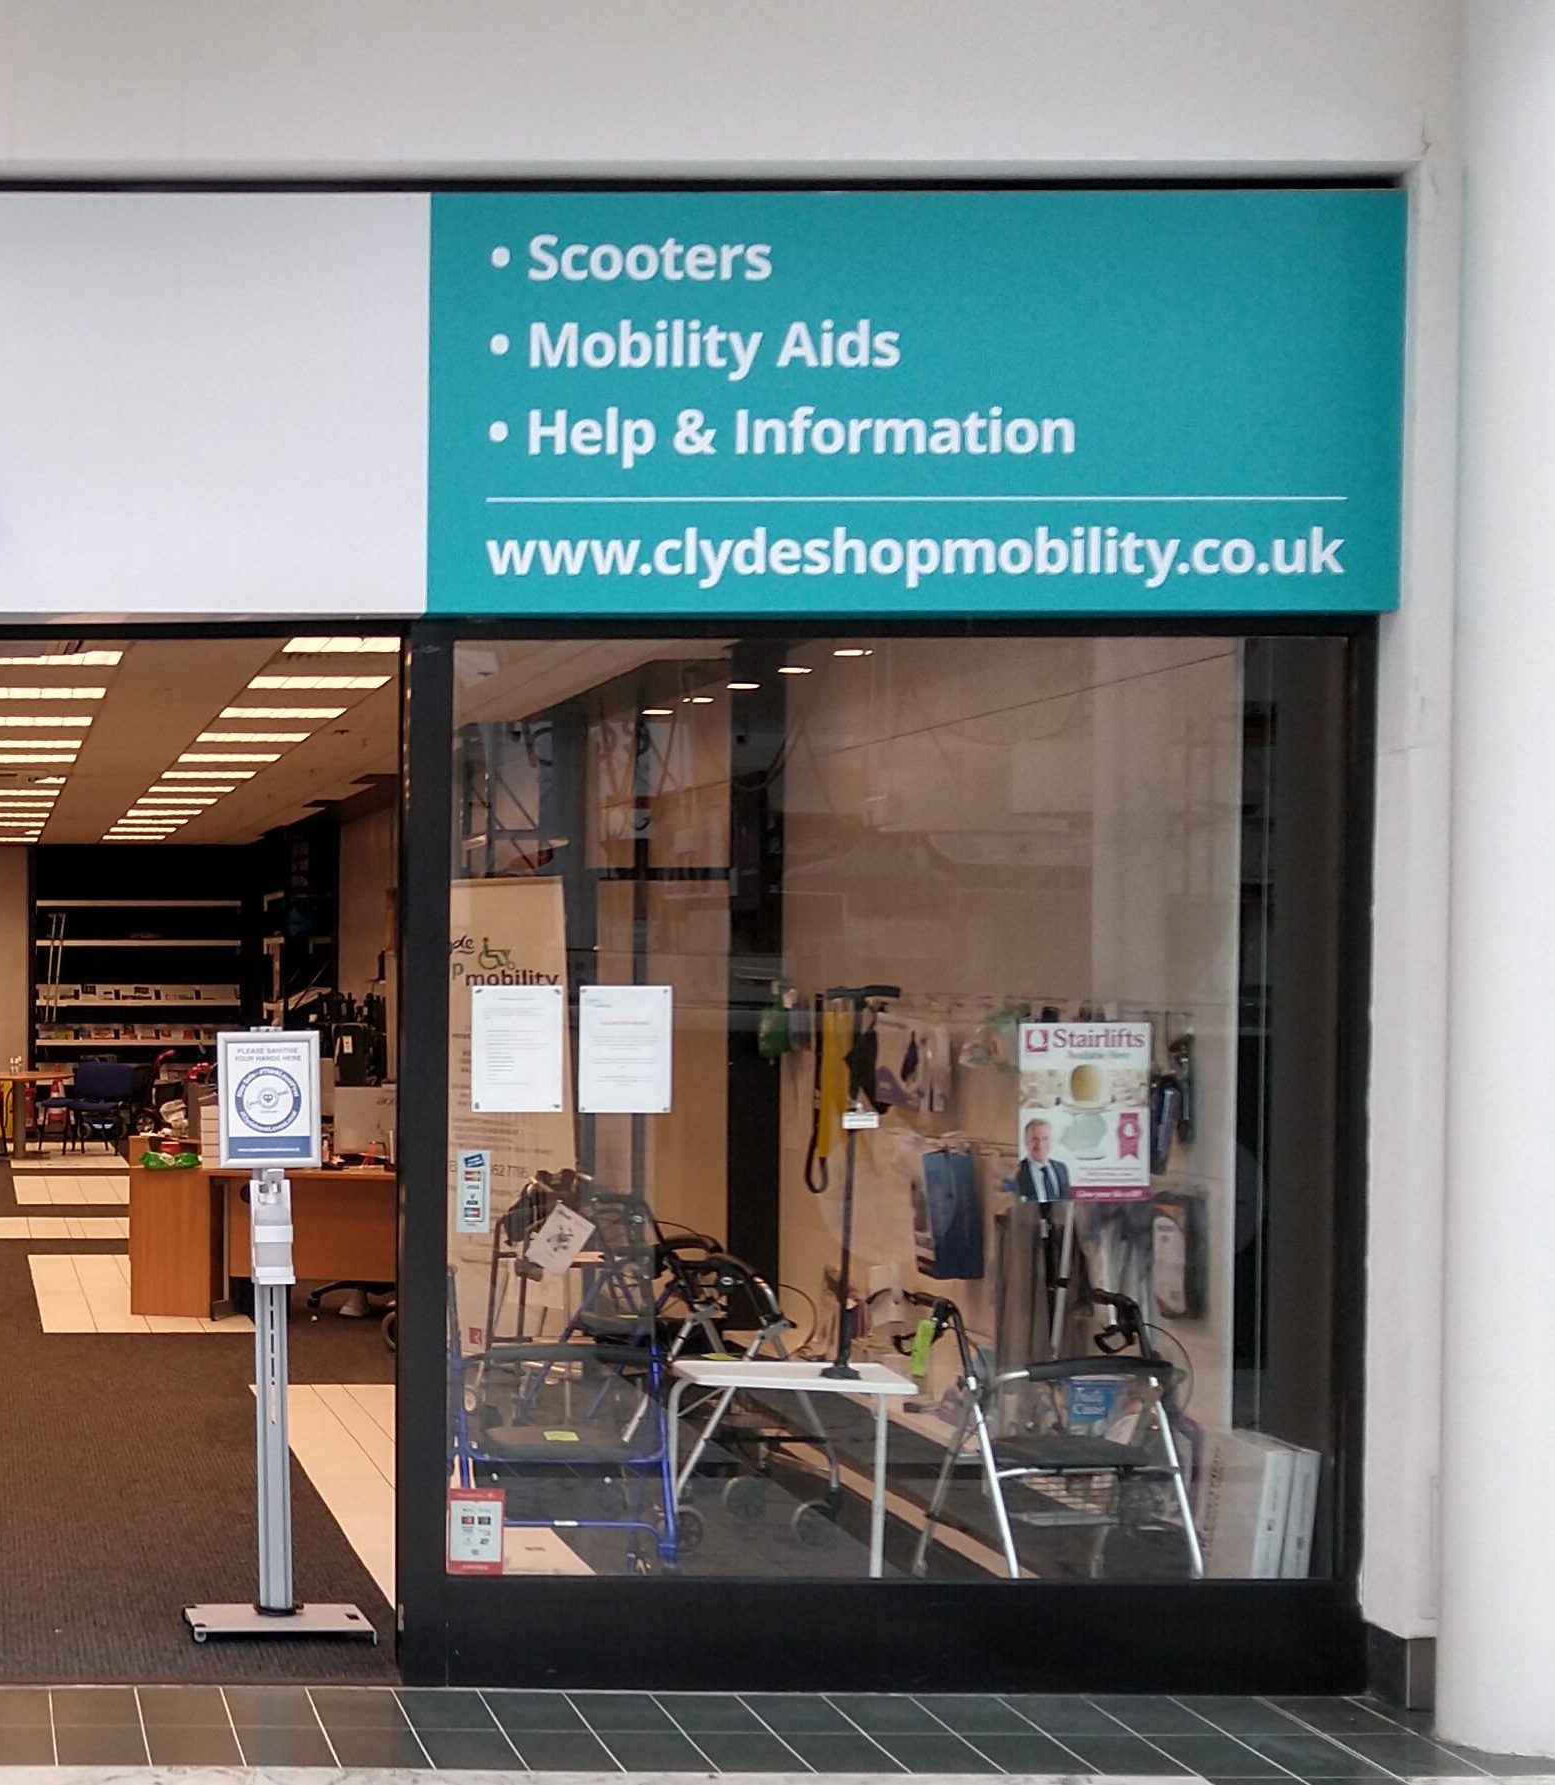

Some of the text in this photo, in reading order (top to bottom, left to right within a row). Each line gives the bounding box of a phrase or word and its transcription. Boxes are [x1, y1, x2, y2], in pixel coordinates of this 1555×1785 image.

[528, 234, 773, 282] Scooters
[529, 318, 901, 381] Mobility Aids
[527, 406, 1076, 469] Help & Information
[487, 525, 1345, 589] www.clydeshopmobility.co.uk
[465, 970, 560, 987] mobility
[1052, 1028, 1145, 1049] Stairlifts
